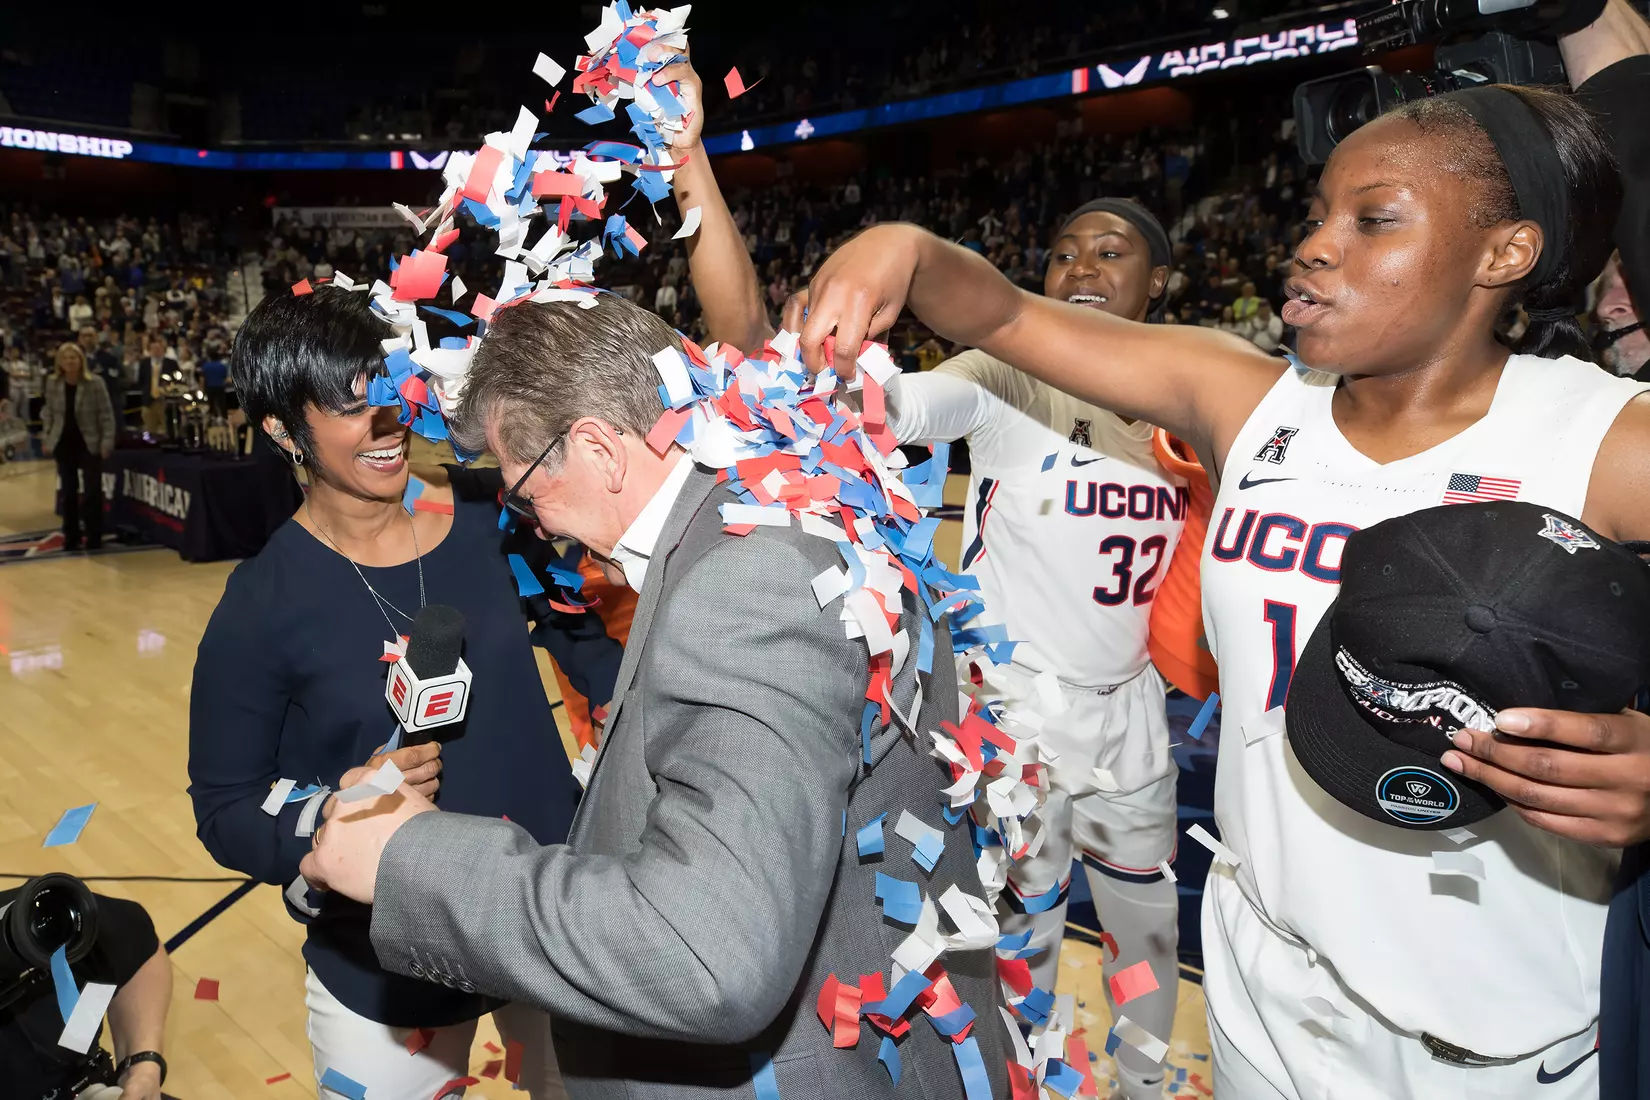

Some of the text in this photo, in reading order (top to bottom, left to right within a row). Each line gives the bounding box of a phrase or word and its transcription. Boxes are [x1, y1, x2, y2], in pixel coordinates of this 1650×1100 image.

[0, 126, 133, 159] IONSHIP
[1093, 534, 1168, 607] 32
[1211, 507, 1360, 584] UCO
[1389, 793, 1406, 802] TOP
[1413, 798, 1445, 808] WORLD
